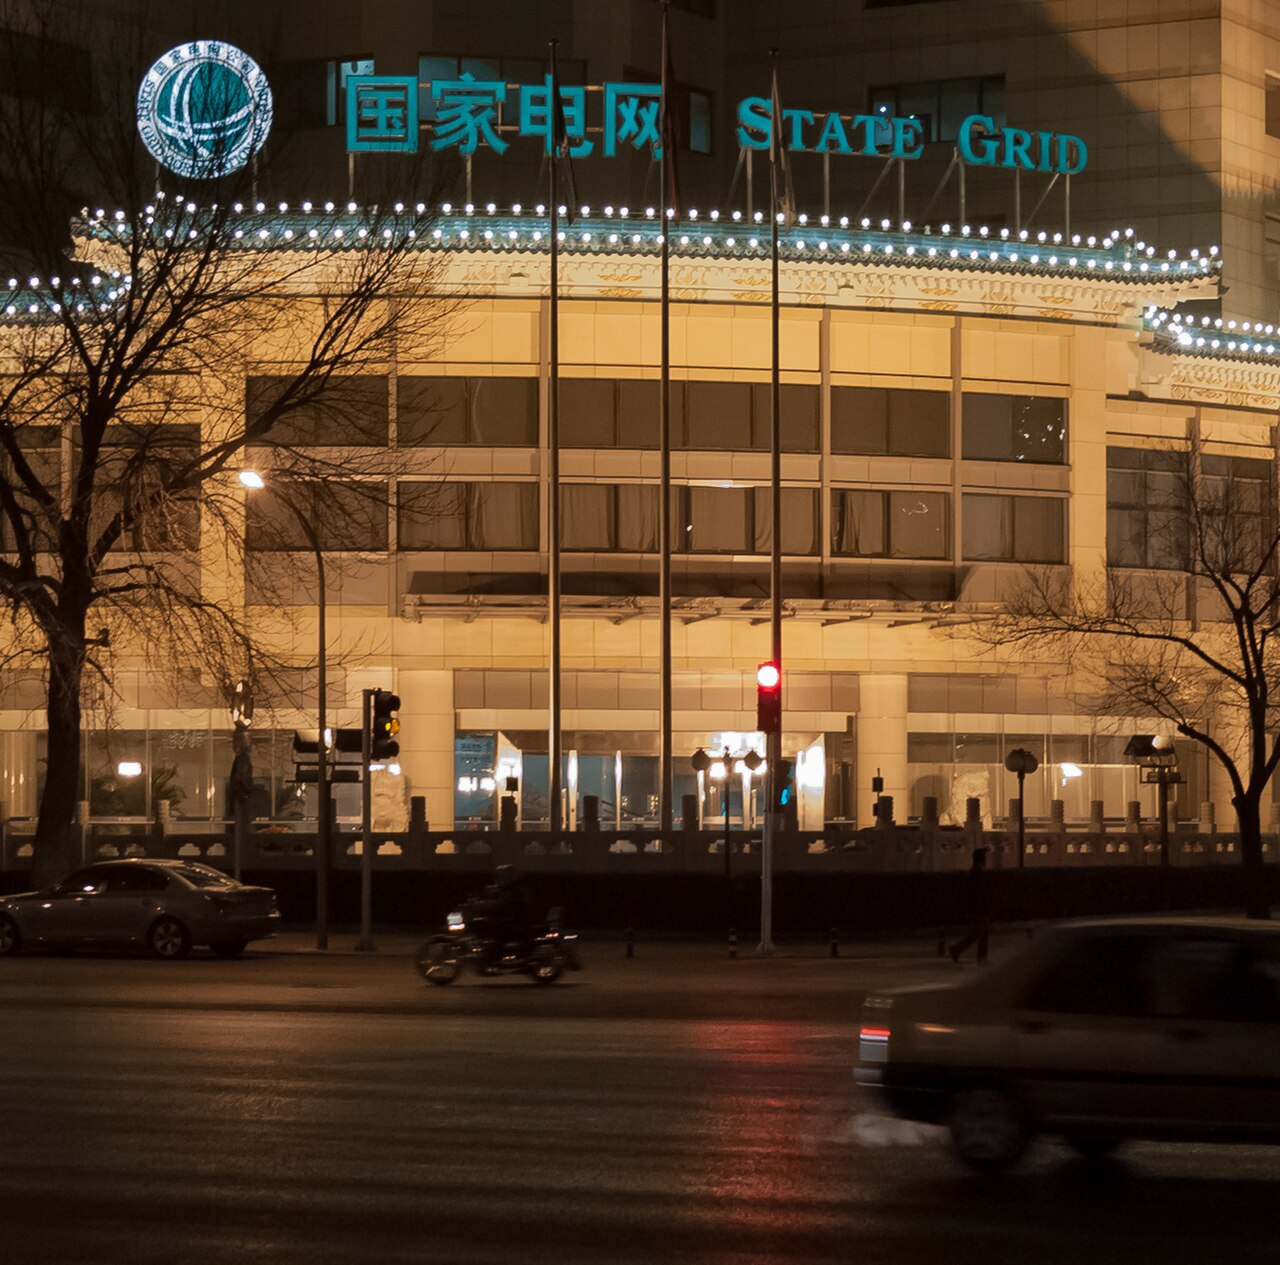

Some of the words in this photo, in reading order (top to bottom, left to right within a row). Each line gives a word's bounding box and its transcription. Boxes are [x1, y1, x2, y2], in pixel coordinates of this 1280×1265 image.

[346, 71, 664, 159] 国家电网
[735, 96, 925, 159] STATE
[958, 114, 1088, 175] GRID
